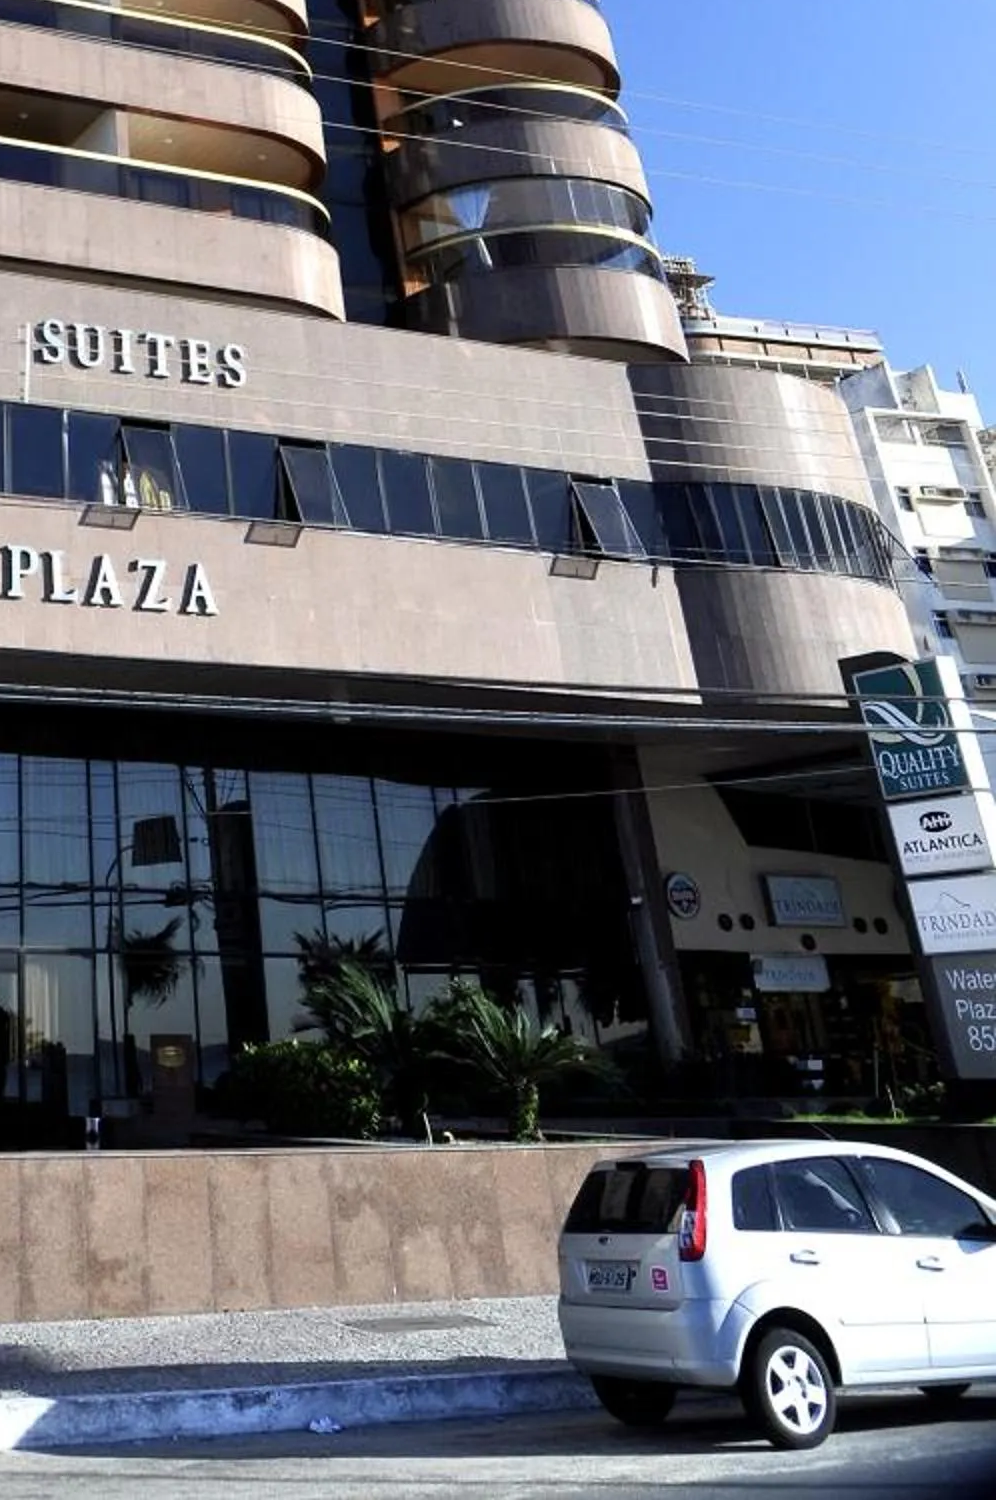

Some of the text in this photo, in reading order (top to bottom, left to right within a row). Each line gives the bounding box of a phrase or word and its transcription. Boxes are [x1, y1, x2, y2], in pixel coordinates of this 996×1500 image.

[32, 317, 247, 389] SUITES
[878, 744, 960, 779] QUALITY
[899, 771, 951, 790] SUITES
[904, 832, 984, 854] ATLANTICA
[945, 968, 996, 990] Wate
[967, 1025, 996, 1051] 85
